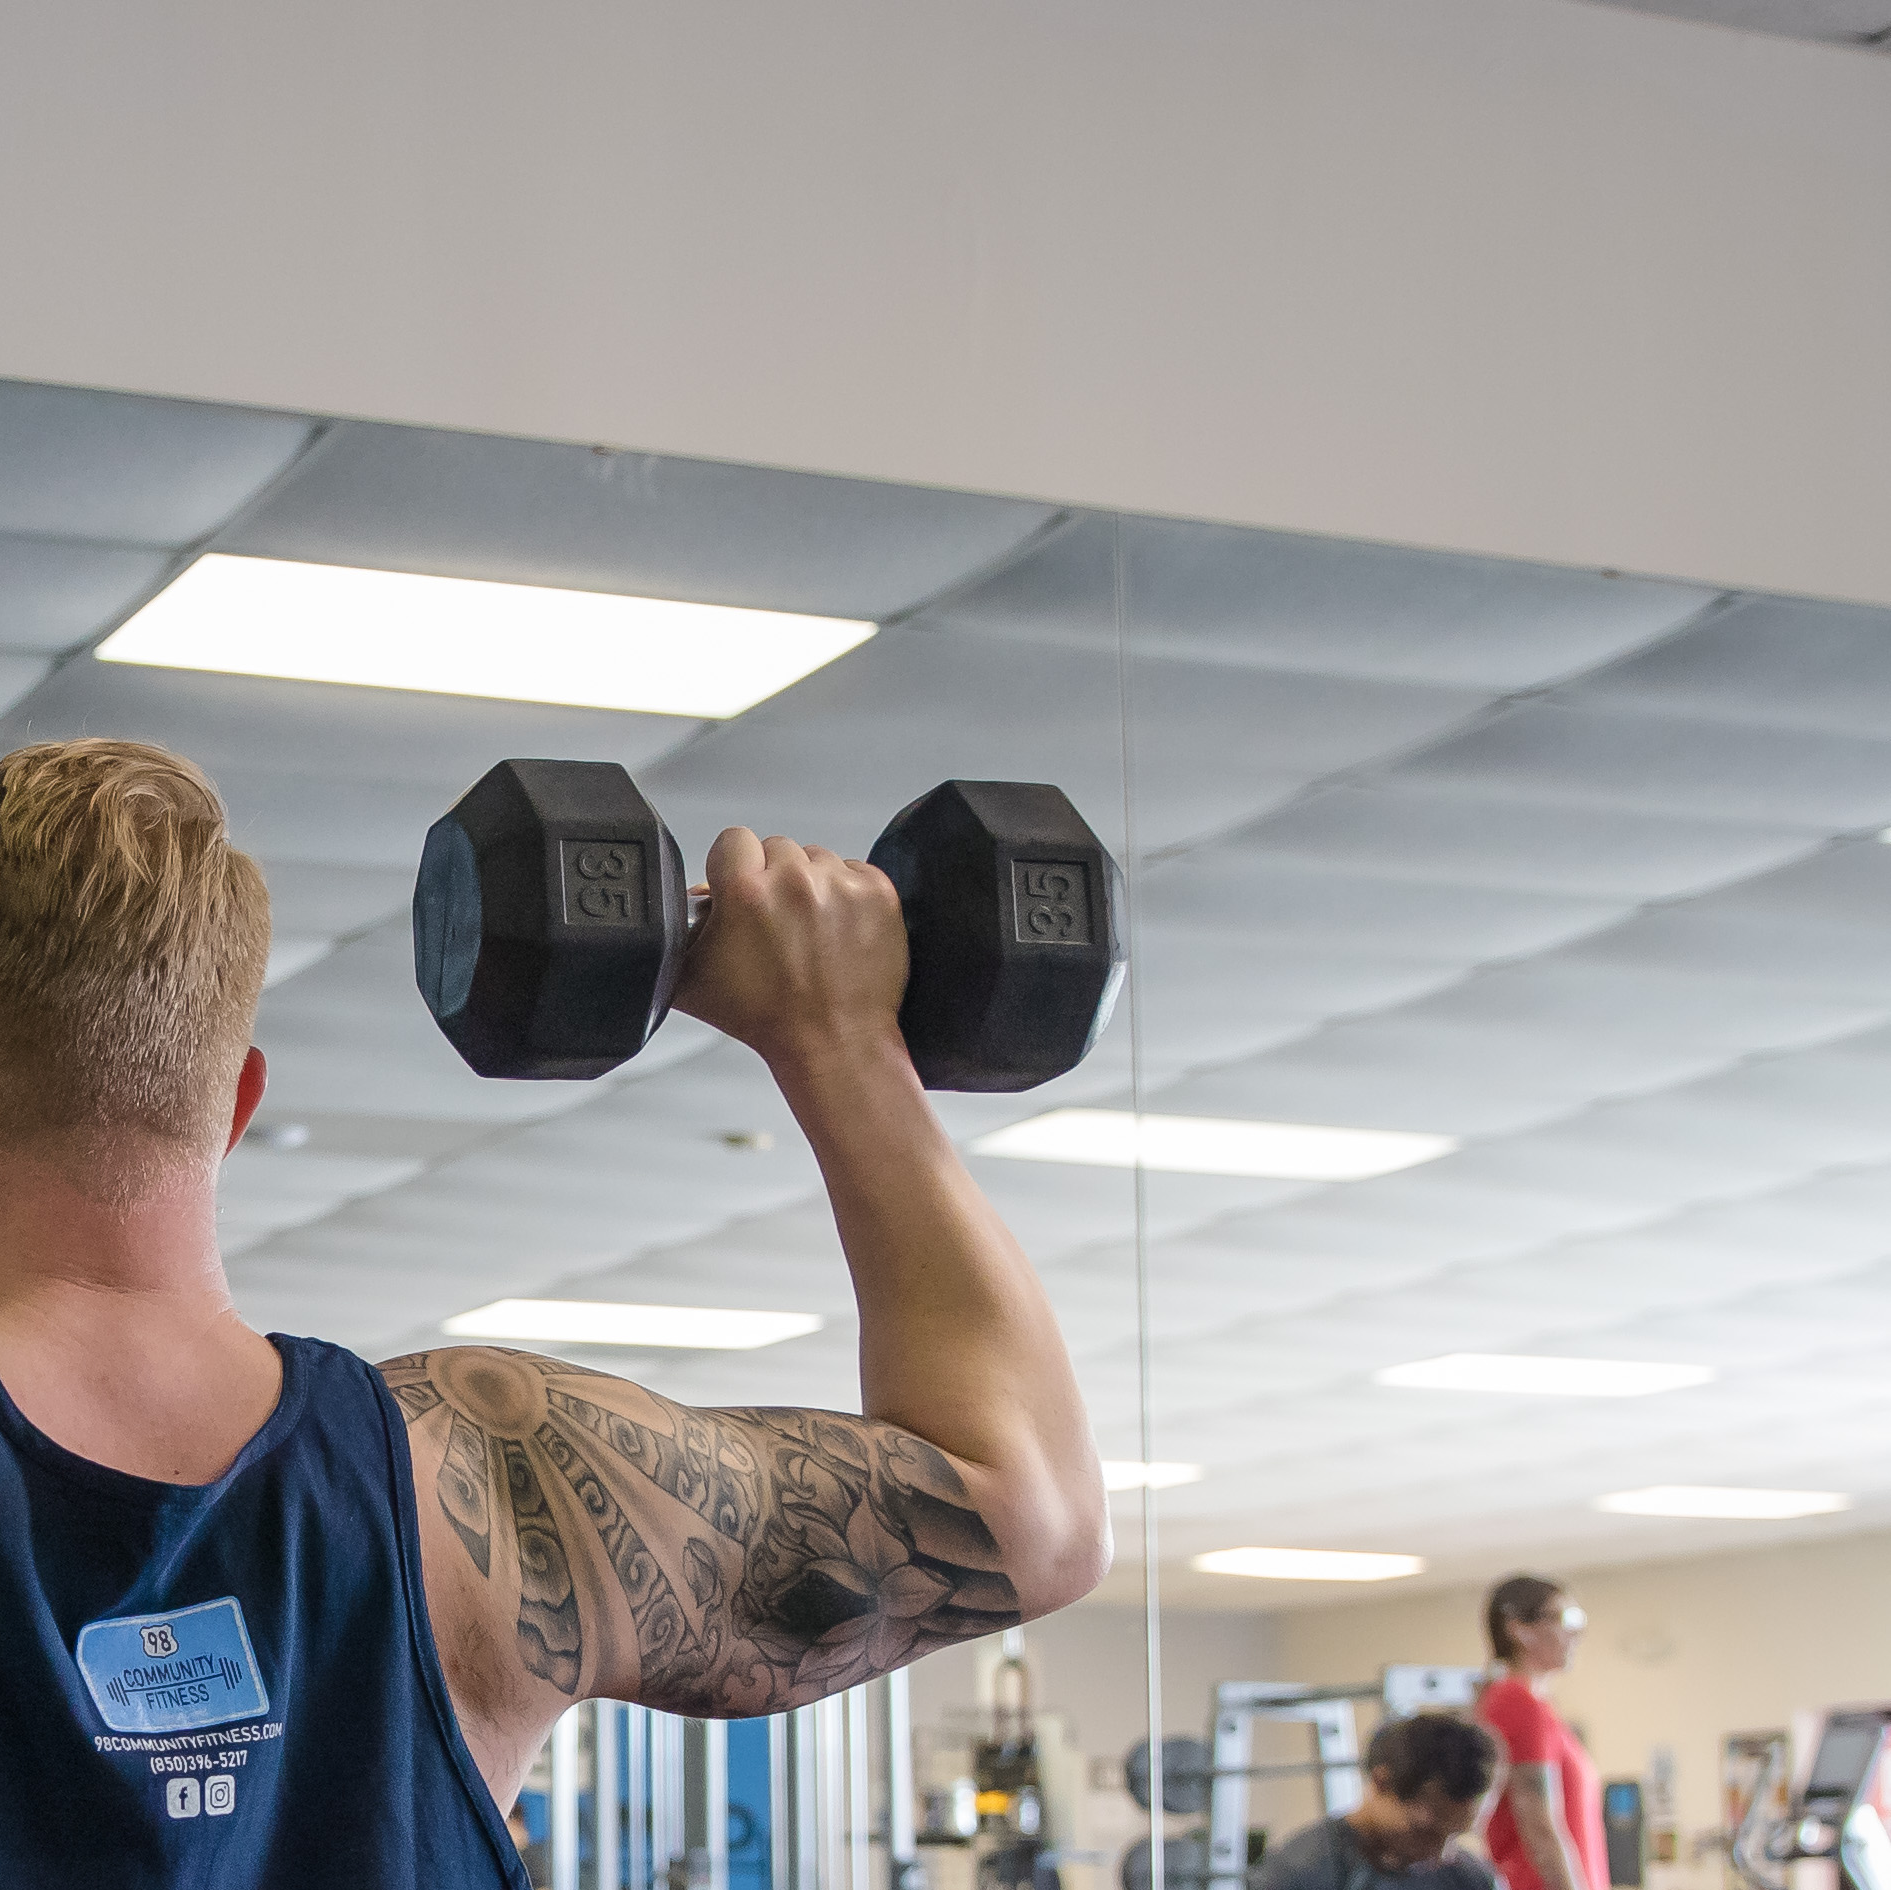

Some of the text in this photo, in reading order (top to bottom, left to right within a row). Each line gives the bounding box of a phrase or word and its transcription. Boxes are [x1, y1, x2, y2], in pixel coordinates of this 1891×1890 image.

[575, 846, 632, 919] 35
[1024, 867, 1075, 937] 35
[147, 1630, 172, 1654] 98
[123, 1653, 216, 1688] COMMUNITY
[146, 1683, 210, 1709] FITNESS
[94, 1722, 283, 1752] 98COMMUNITYFITNESS.COM
[150, 1750, 248, 1775] (850)396-5217
